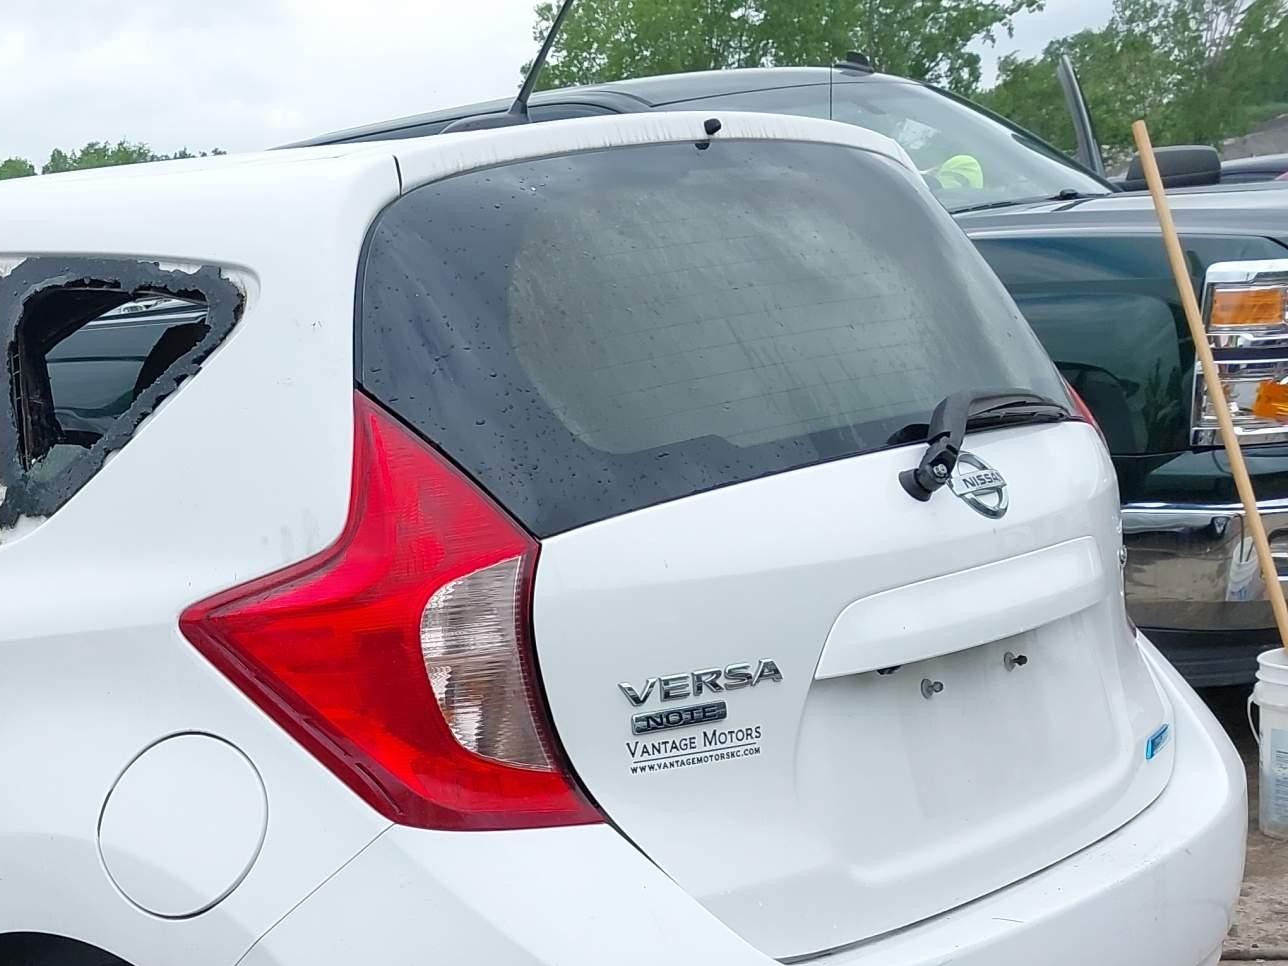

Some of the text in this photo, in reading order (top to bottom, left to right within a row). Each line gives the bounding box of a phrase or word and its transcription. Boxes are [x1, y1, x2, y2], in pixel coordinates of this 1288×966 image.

[617, 658, 784, 706] VERSA
[645, 704, 719, 730] NOTE
[626, 725, 762, 759] VANTAGE MOTORS
[630, 747, 761, 774] WWW.VANTAGEMOTORSKC.COM
